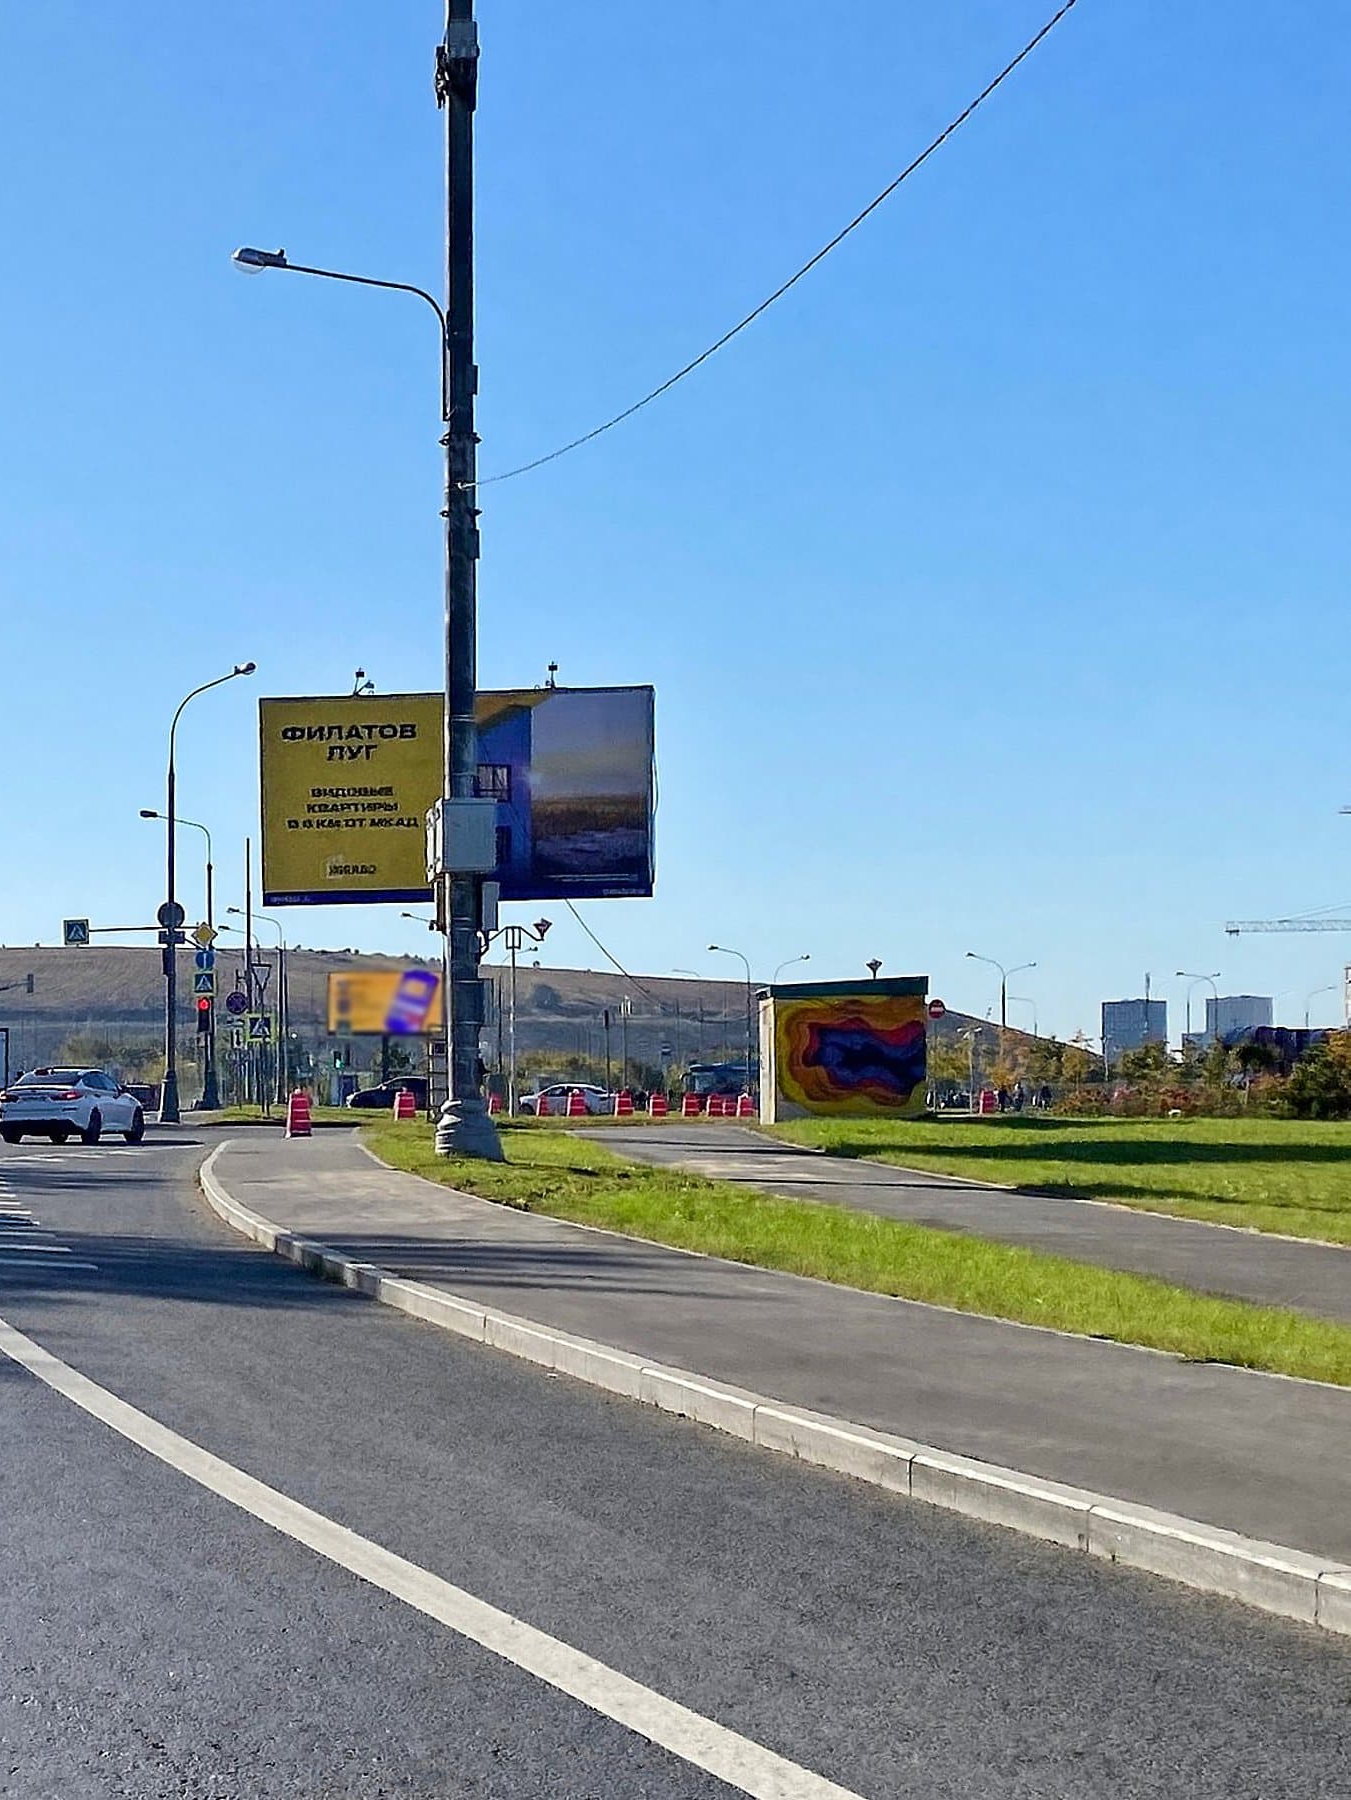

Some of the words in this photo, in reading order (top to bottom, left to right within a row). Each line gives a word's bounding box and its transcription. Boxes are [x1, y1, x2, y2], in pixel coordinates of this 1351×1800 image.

[281, 723, 417, 741] ФИЛАТОВ
[326, 744, 378, 761] ЛУГ
[310, 786, 394, 798] ВИДОВЫЕ
[306, 802, 398, 814] КВАРТИРЫ
[343, 818, 366, 828] ОТ
[369, 817, 419, 828] МКАД
